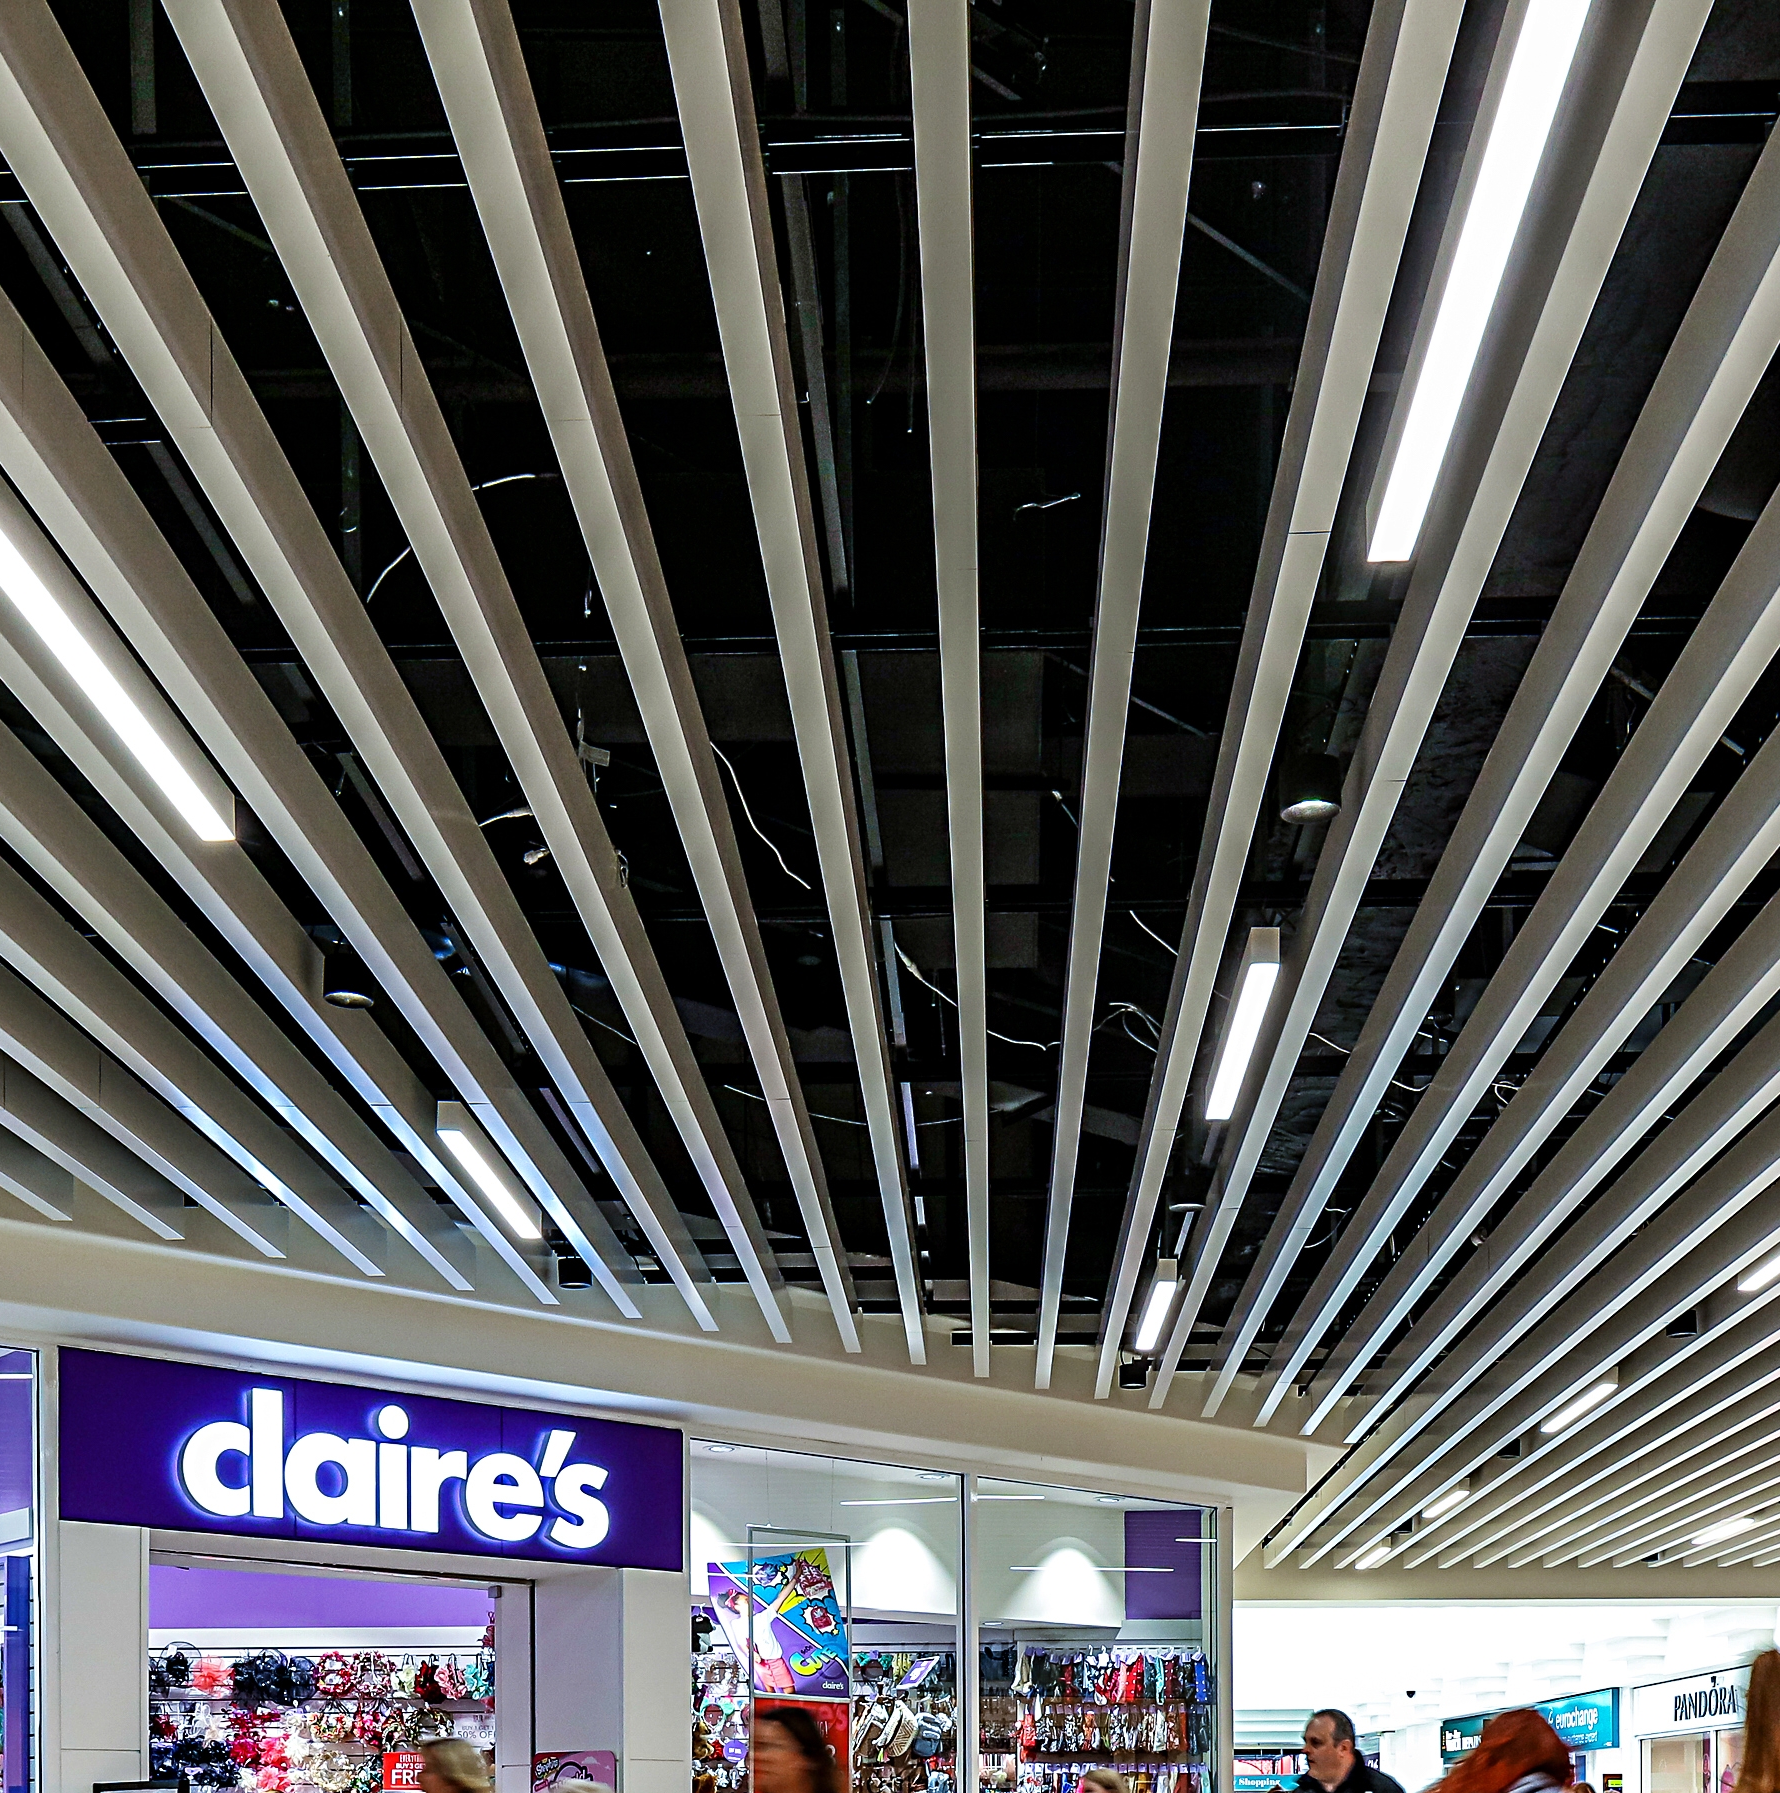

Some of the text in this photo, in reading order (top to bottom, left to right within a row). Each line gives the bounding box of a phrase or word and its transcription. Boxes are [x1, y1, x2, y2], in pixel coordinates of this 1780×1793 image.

[177, 1387, 610, 1550] claire's
[822, 1681, 844, 1690] claire's
[1674, 1682, 1738, 1722] PANDORA
[1555, 1705, 1599, 1731] eurochange
[457, 1730, 477, 1739] 50%
[391, 1769, 423, 1785] FRE
[1238, 1777, 1281, 1788] Shopping
